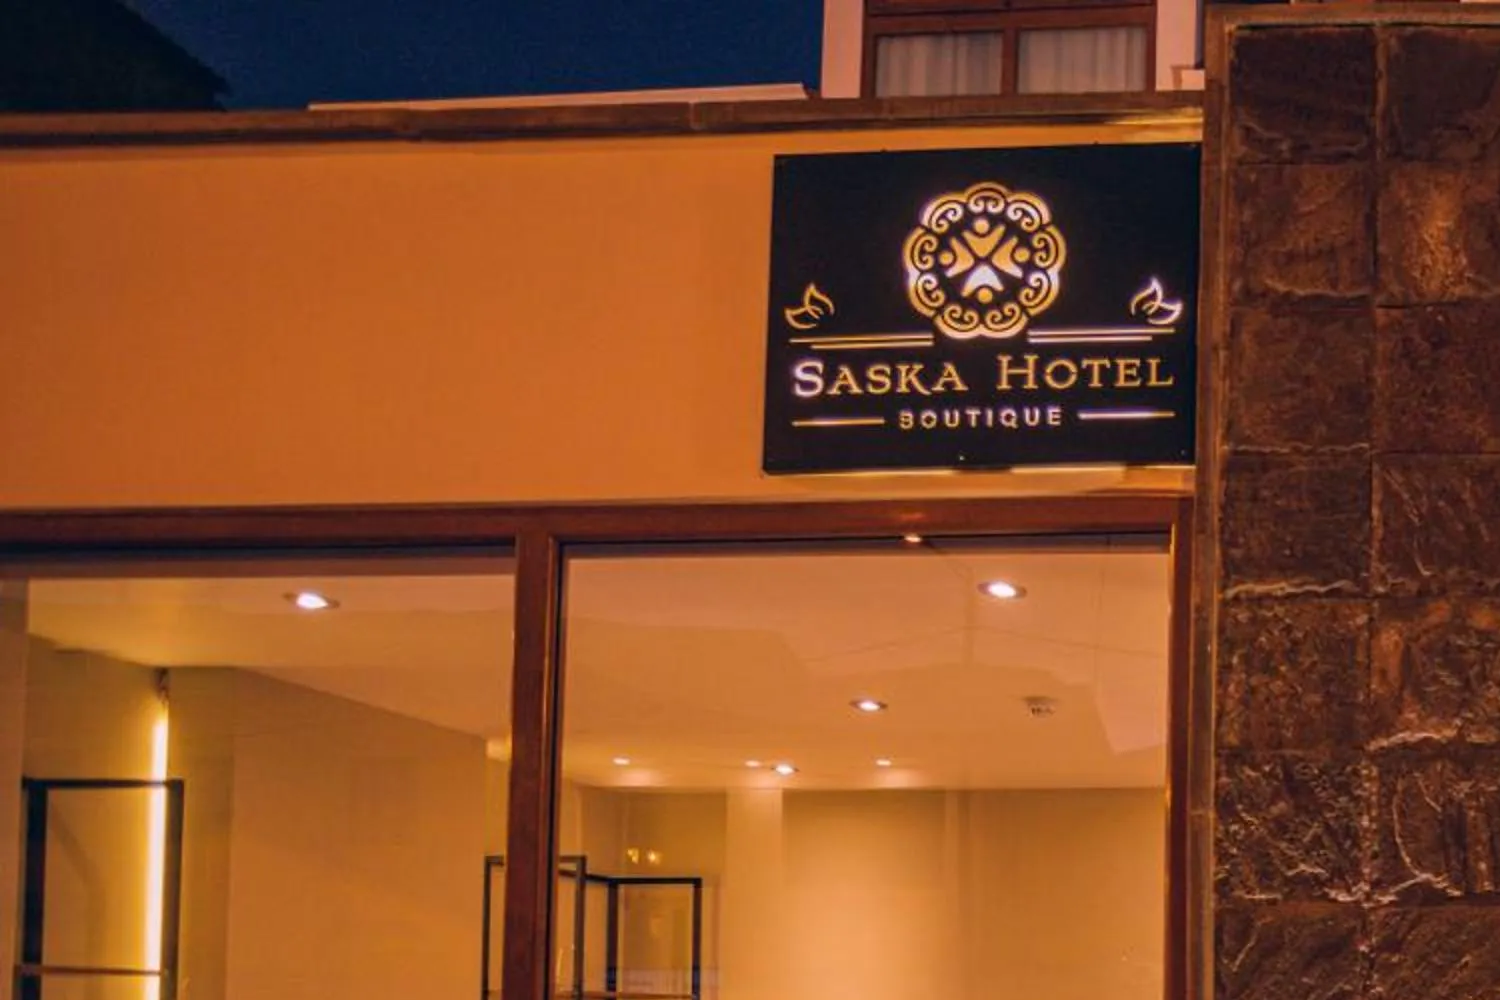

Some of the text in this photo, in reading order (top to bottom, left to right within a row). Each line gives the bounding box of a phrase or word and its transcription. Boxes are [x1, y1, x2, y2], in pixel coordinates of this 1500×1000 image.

[793, 354, 1174, 396] SASKA HOTEL
[899, 406, 1063, 429] BOUTIQUE
